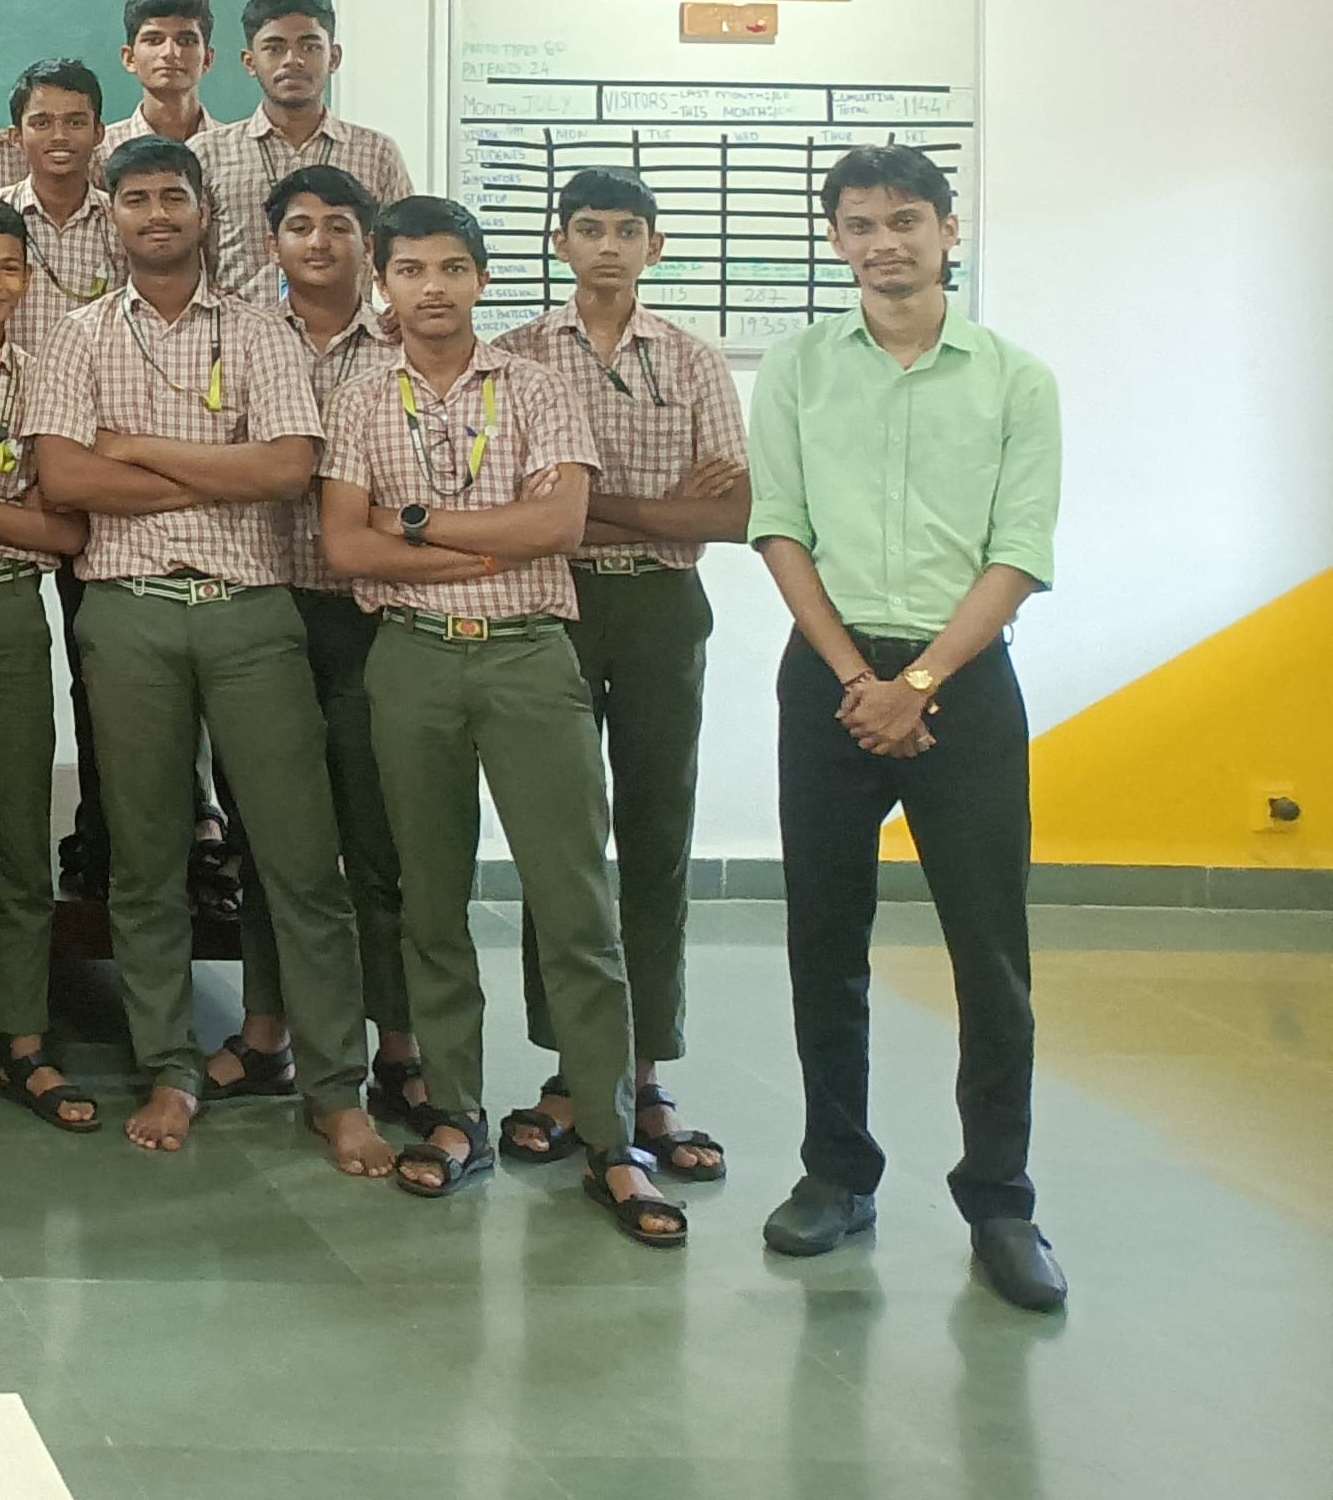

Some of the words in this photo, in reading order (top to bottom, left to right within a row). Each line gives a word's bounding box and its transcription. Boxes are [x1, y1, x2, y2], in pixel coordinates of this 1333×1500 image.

[462, 93, 517, 117] MONTH
[603, 90, 669, 113] VISITORS
[835, 103, 870, 115] TOTAL
[556, 129, 588, 141] MON
[734, 131, 759, 142] WED
[464, 148, 526, 164] STUDENTS
[660, 287, 688, 303] 115
